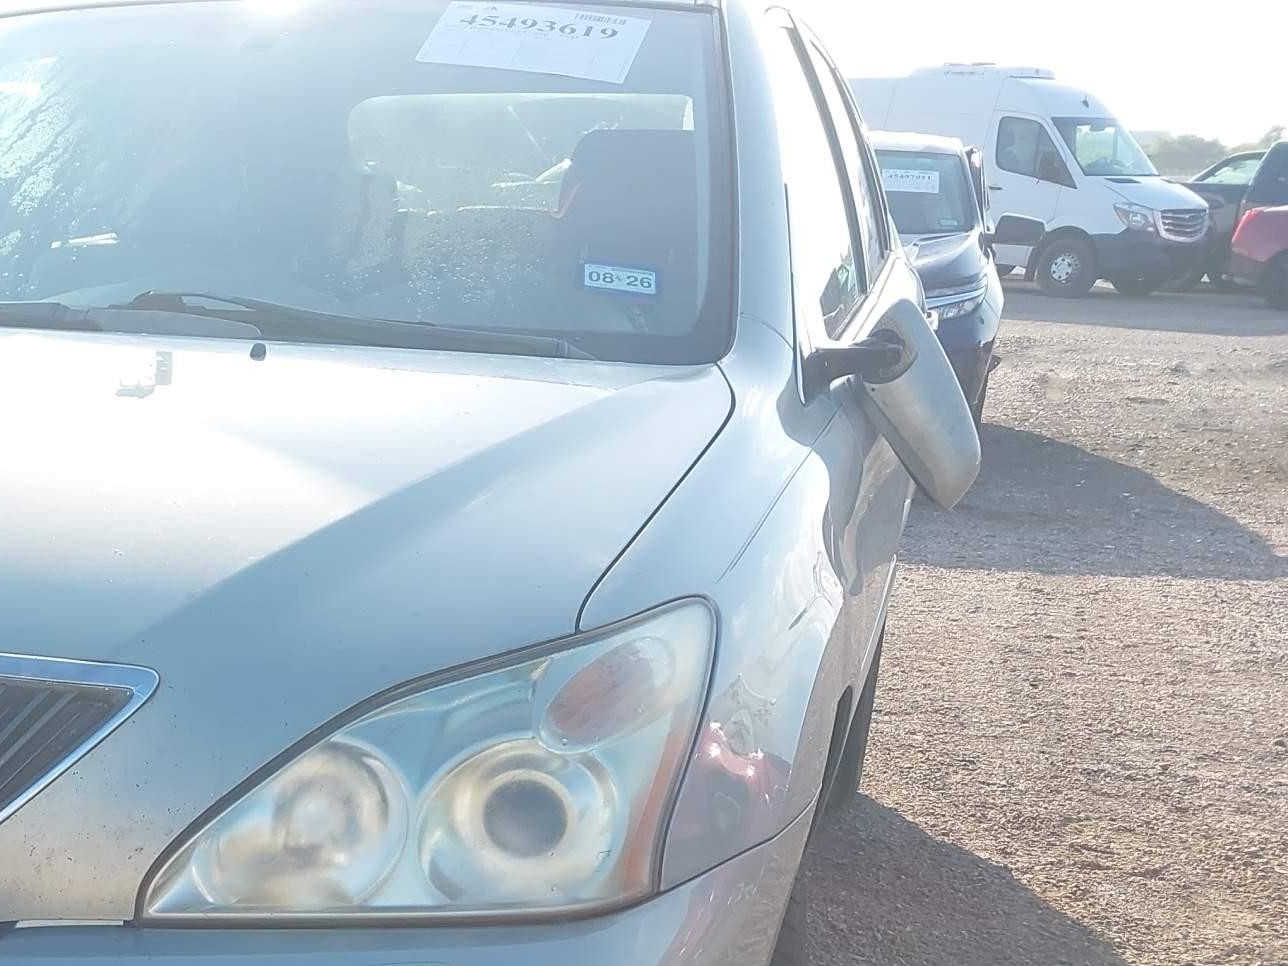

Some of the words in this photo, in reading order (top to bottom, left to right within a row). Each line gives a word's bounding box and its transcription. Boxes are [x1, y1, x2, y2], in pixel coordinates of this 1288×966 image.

[459, 13, 619, 40] 45493619
[588, 271, 615, 284] 08
[626, 275, 652, 289] 26
